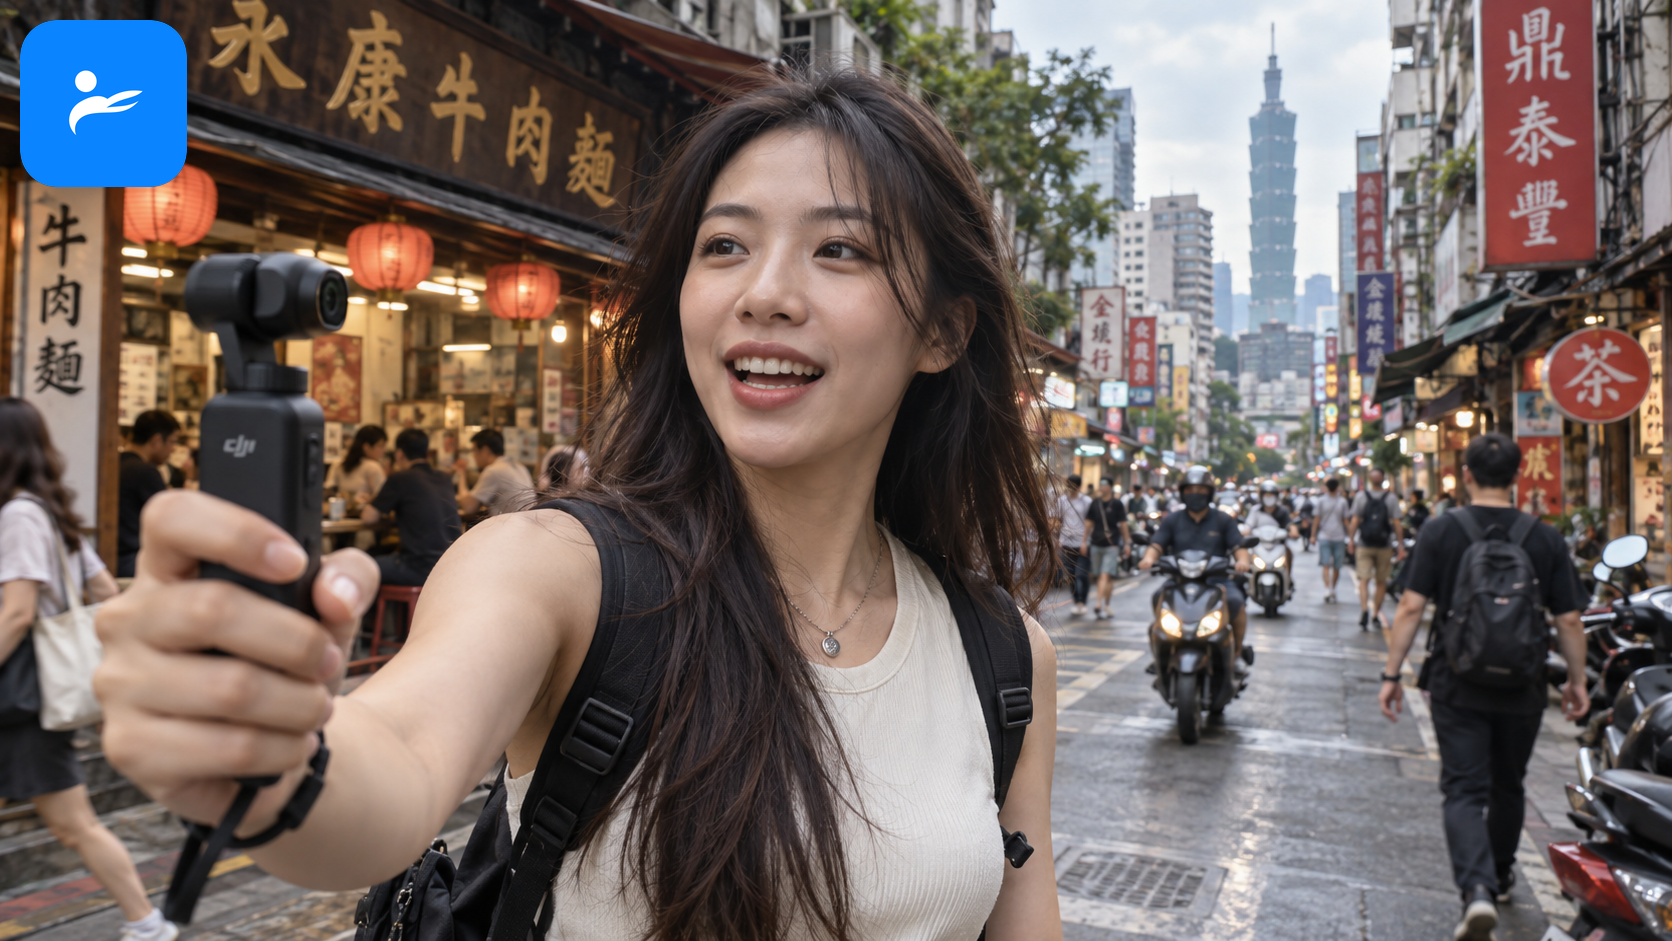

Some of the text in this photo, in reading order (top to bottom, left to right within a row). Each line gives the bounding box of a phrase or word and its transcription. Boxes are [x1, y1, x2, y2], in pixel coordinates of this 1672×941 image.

[208, 0, 617, 208] 永康牛肉麵
[1504, 6, 1577, 247] 鼎泰豐
[34, 204, 87, 396] 牛肉麵
[1562, 338, 1638, 408] 茶
